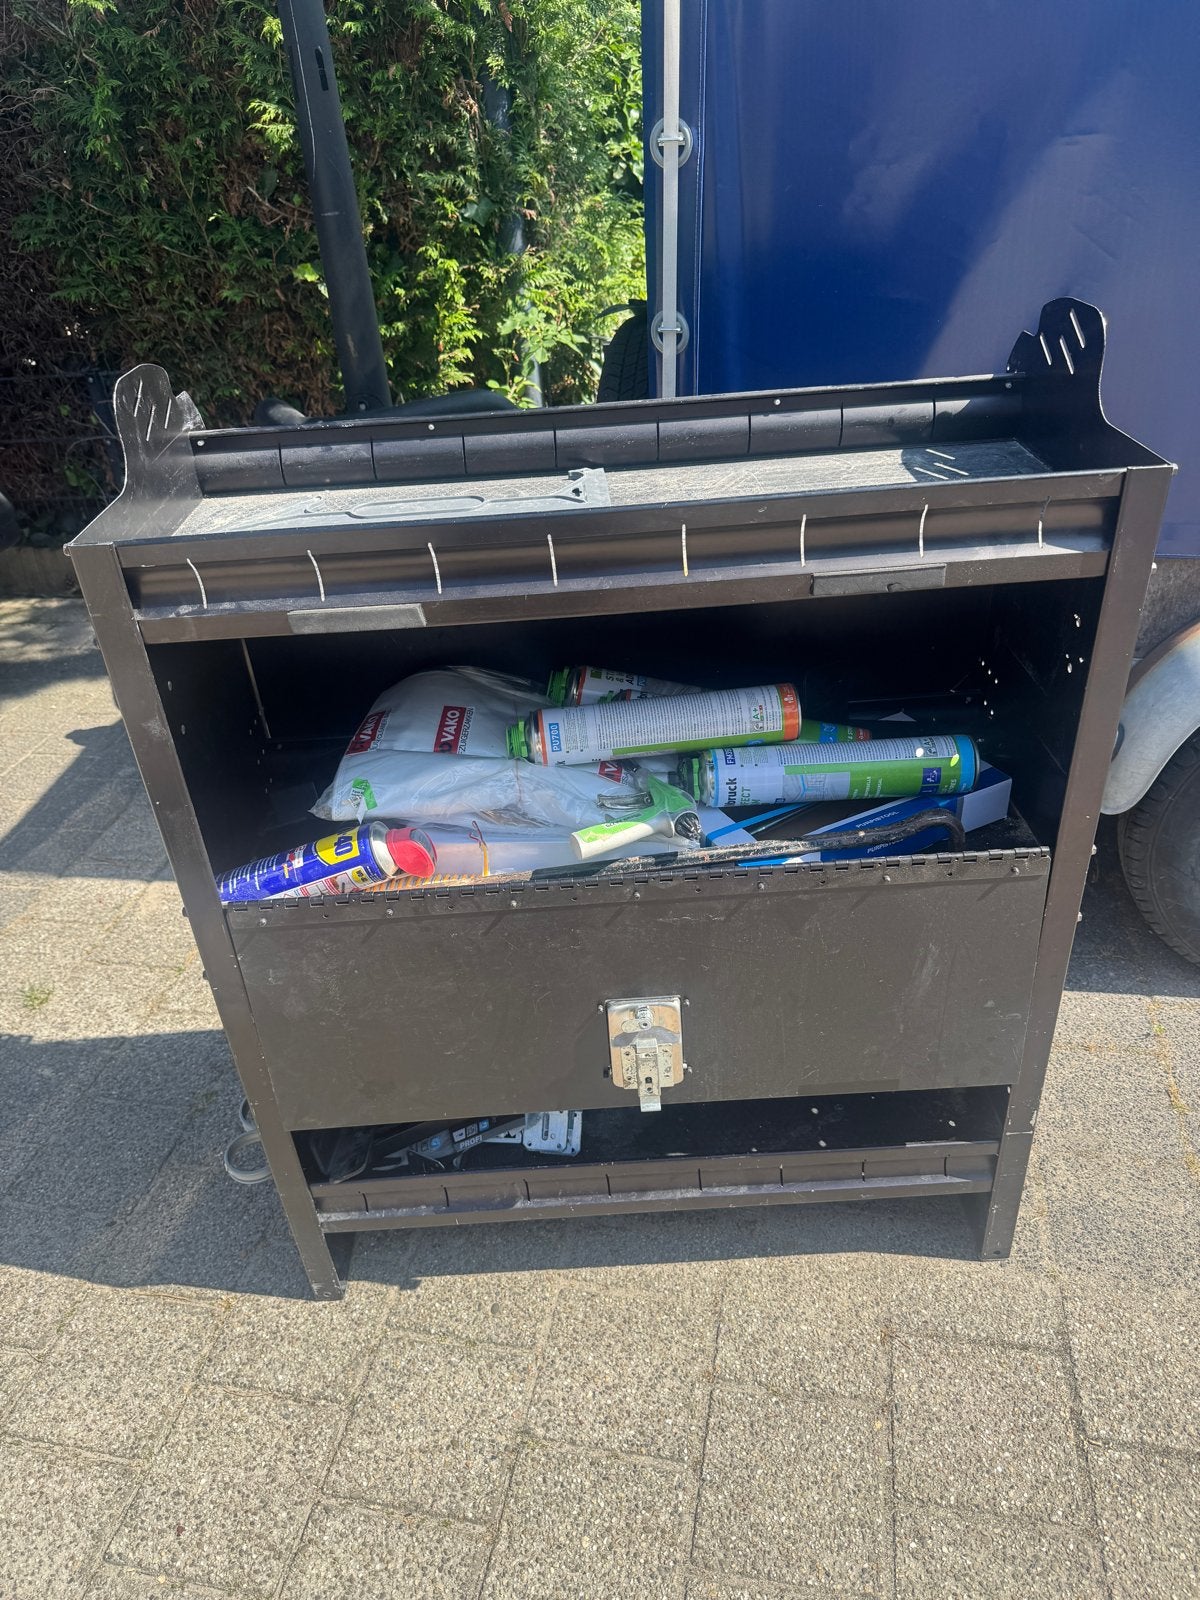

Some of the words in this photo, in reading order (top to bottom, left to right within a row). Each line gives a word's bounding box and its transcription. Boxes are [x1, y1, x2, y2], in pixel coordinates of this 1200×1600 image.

[440, 709, 459, 743] VAKO
[551, 724, 559, 751] PU700
[459, 1134, 483, 1149] PROFI
